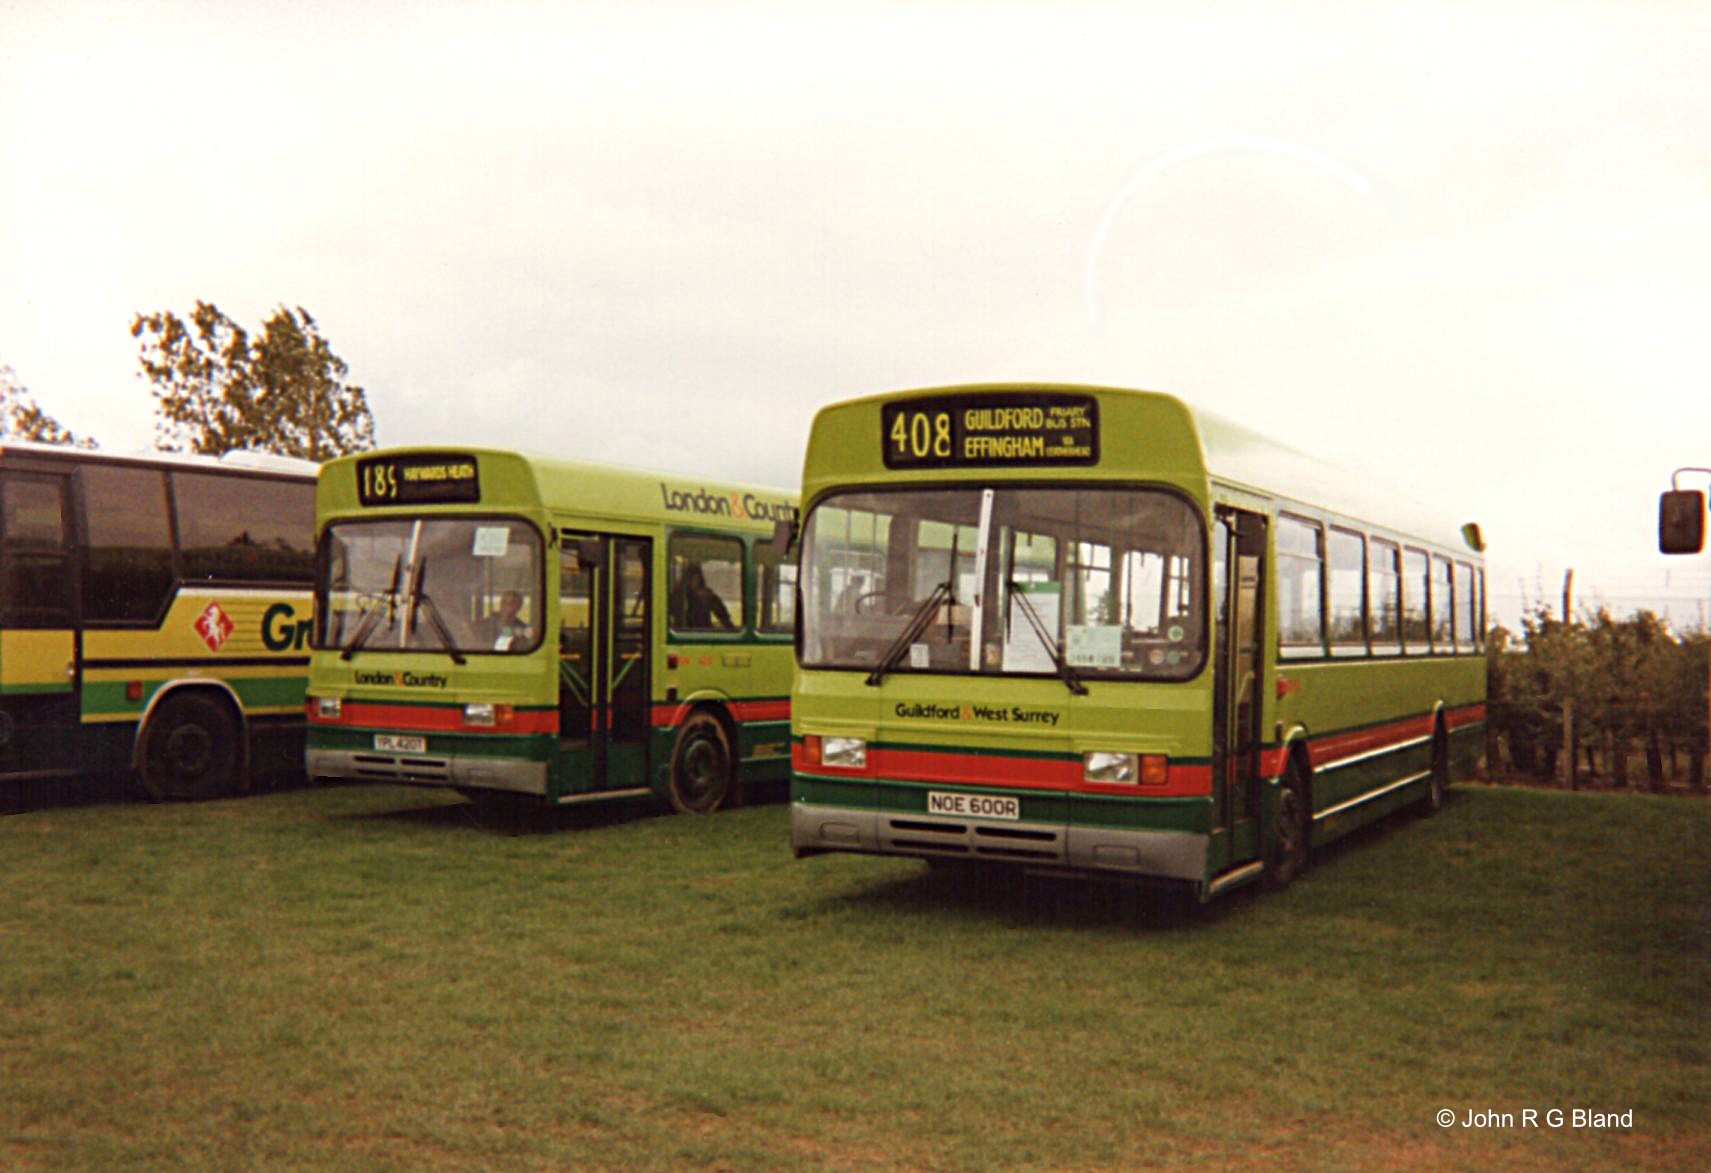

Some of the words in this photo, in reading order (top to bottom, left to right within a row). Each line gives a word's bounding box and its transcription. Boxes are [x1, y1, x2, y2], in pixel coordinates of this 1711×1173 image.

[965, 407, 1044, 430] GUILDFORD
[890, 412, 950, 458] 408
[965, 436, 1044, 458] EFFINGHAM
[659, 481, 731, 517] London
[354, 670, 394, 686] London
[402, 671, 448, 690] Country
[895, 703, 960, 720] Guildford
[973, 705, 1009, 721] West
[1011, 707, 1060, 726] Surrey
[930, 795, 966, 813] NOE
[969, 797, 1017, 817] 600R
